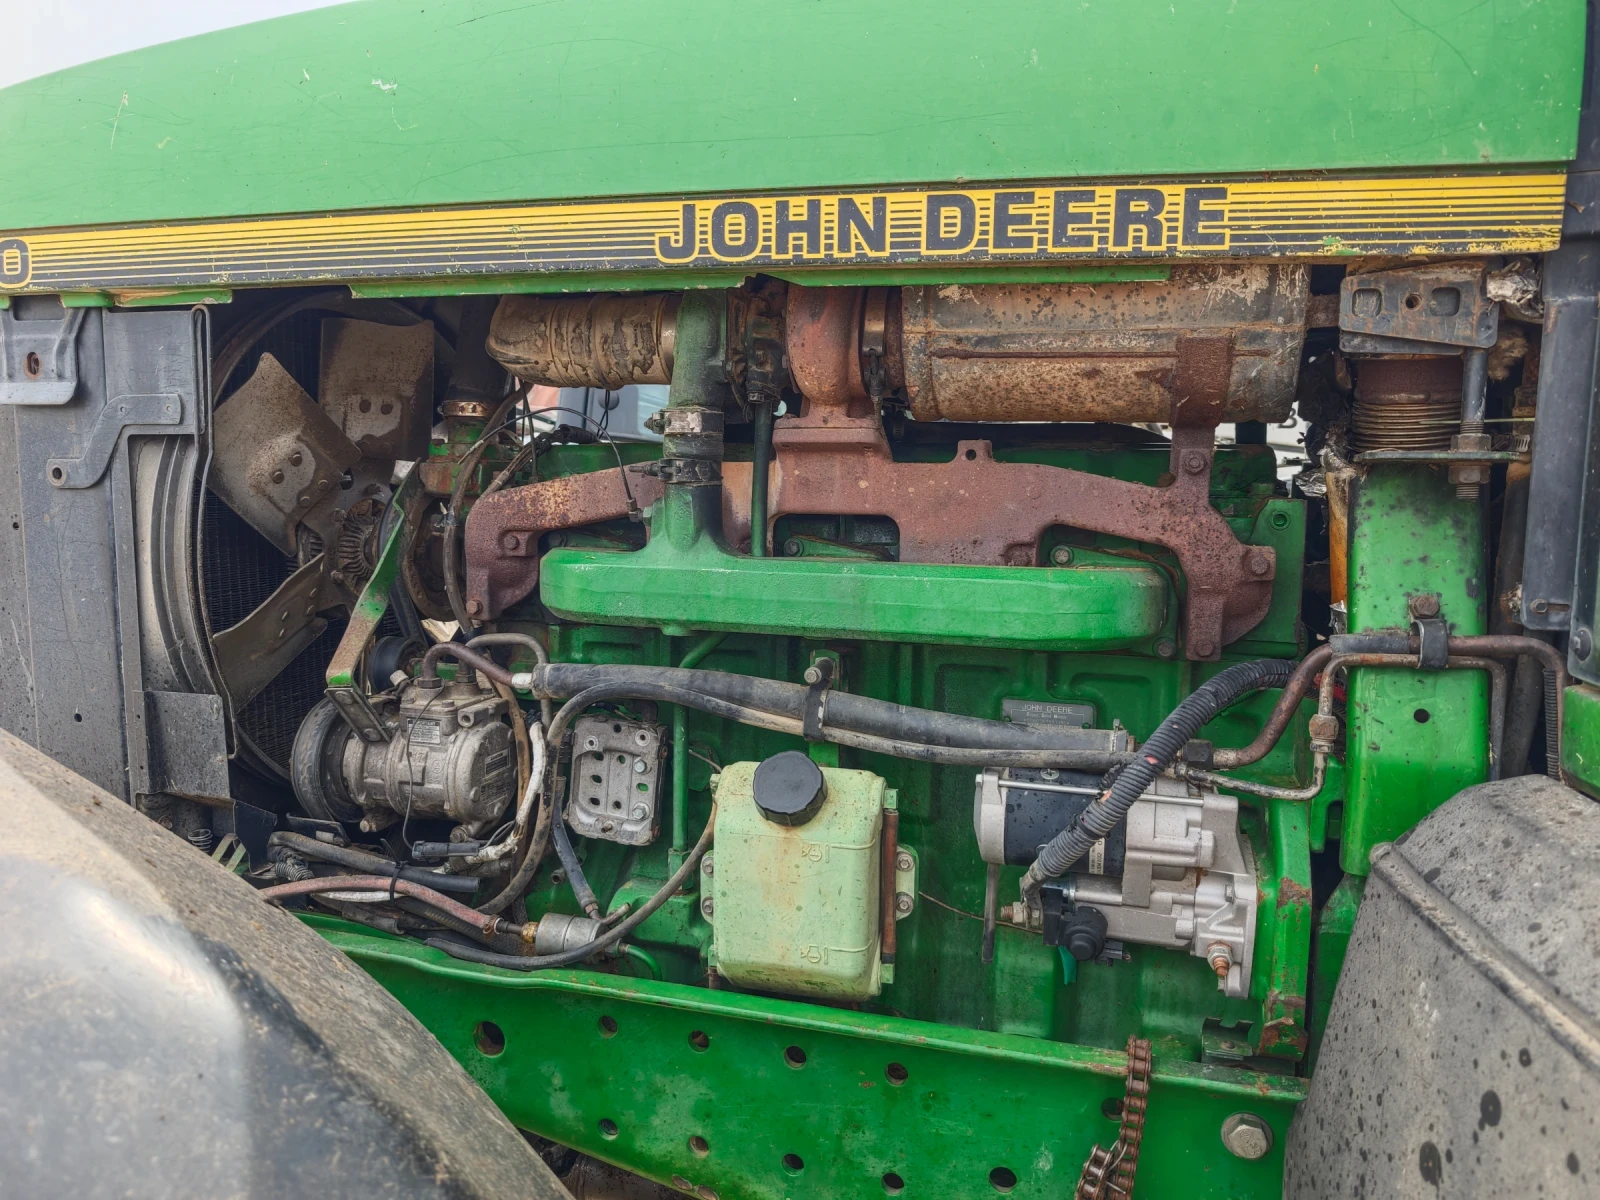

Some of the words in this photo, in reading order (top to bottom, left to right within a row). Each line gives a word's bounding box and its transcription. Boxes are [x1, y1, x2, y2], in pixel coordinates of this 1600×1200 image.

[654, 195, 890, 264] JOHN
[921, 185, 1231, 256] DEERE
[1021, 703, 1043, 712] JOHN
[1046, 705, 1073, 714] DEERE
